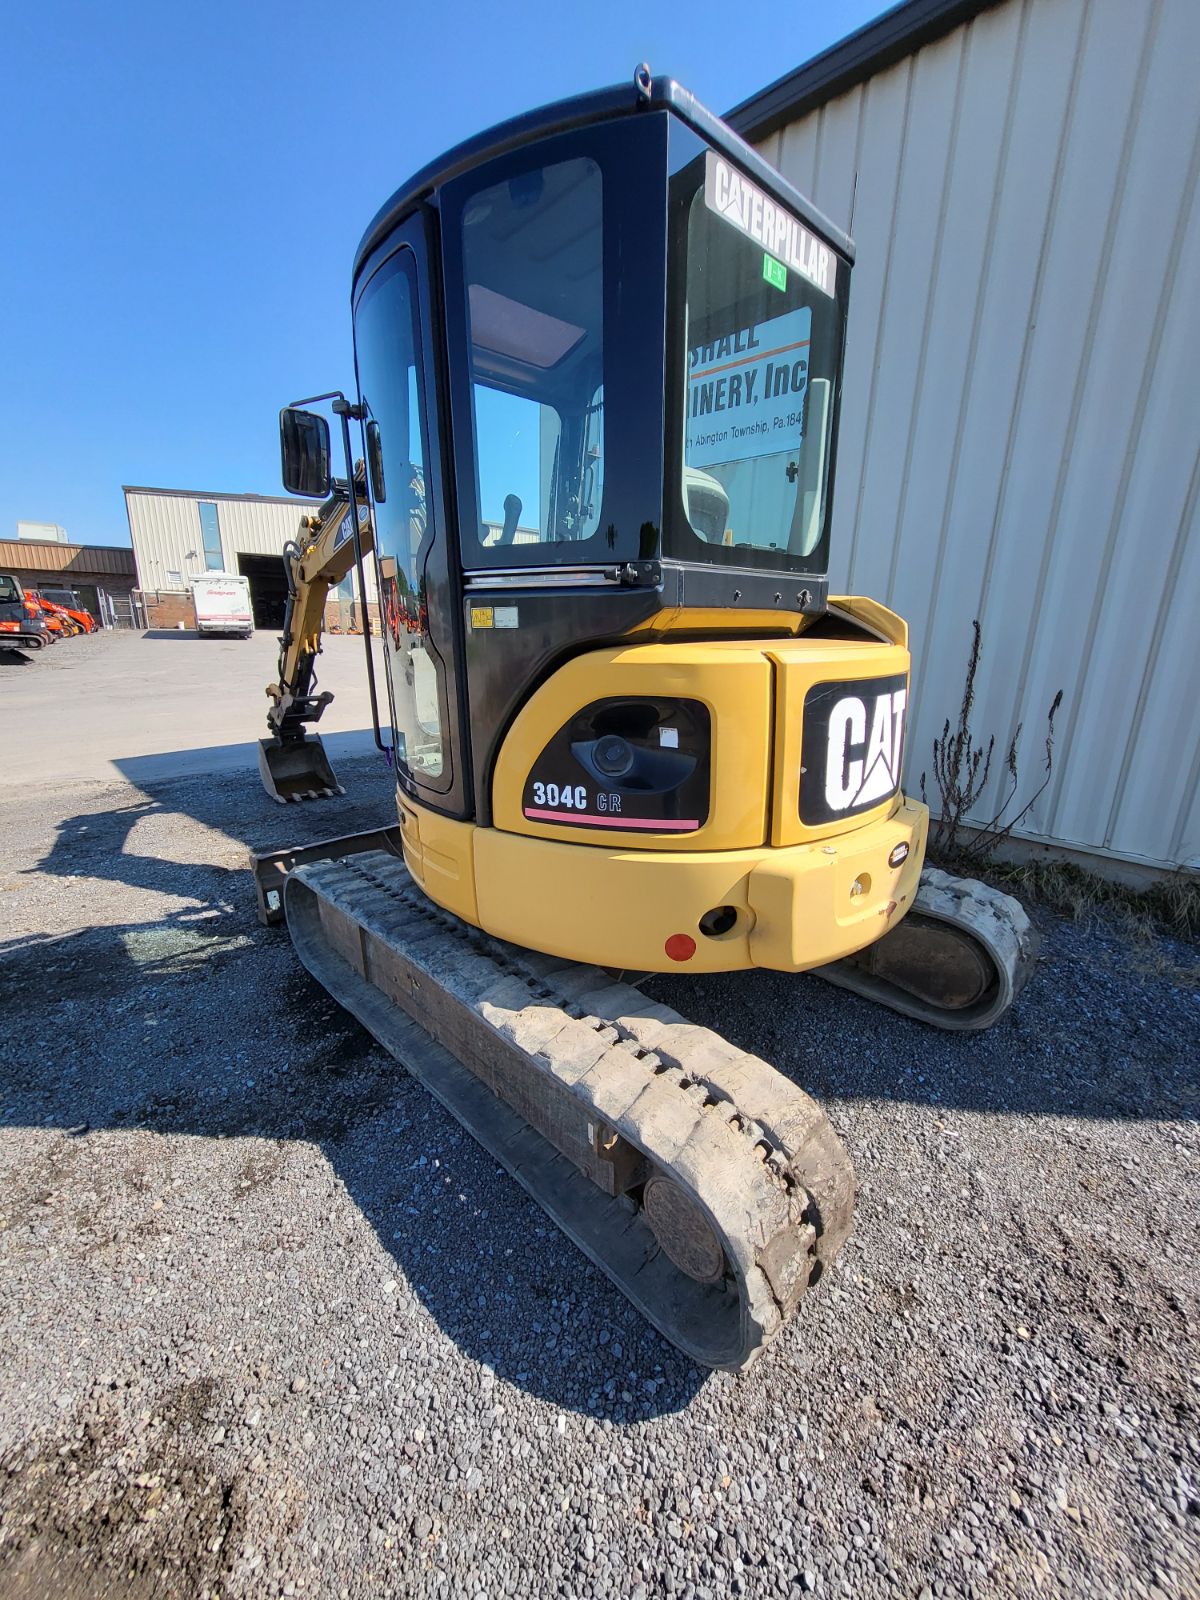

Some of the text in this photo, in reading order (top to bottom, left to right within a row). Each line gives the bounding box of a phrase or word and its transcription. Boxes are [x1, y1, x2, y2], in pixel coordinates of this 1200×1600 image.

[715, 162, 829, 290] CATERPILLAR
[687, 368, 758, 419] INERY,
[695, 431, 728, 447] Abington
[730, 422, 770, 440] Township,
[825, 689, 907, 812] CAT
[533, 782, 622, 812] 304C CR
